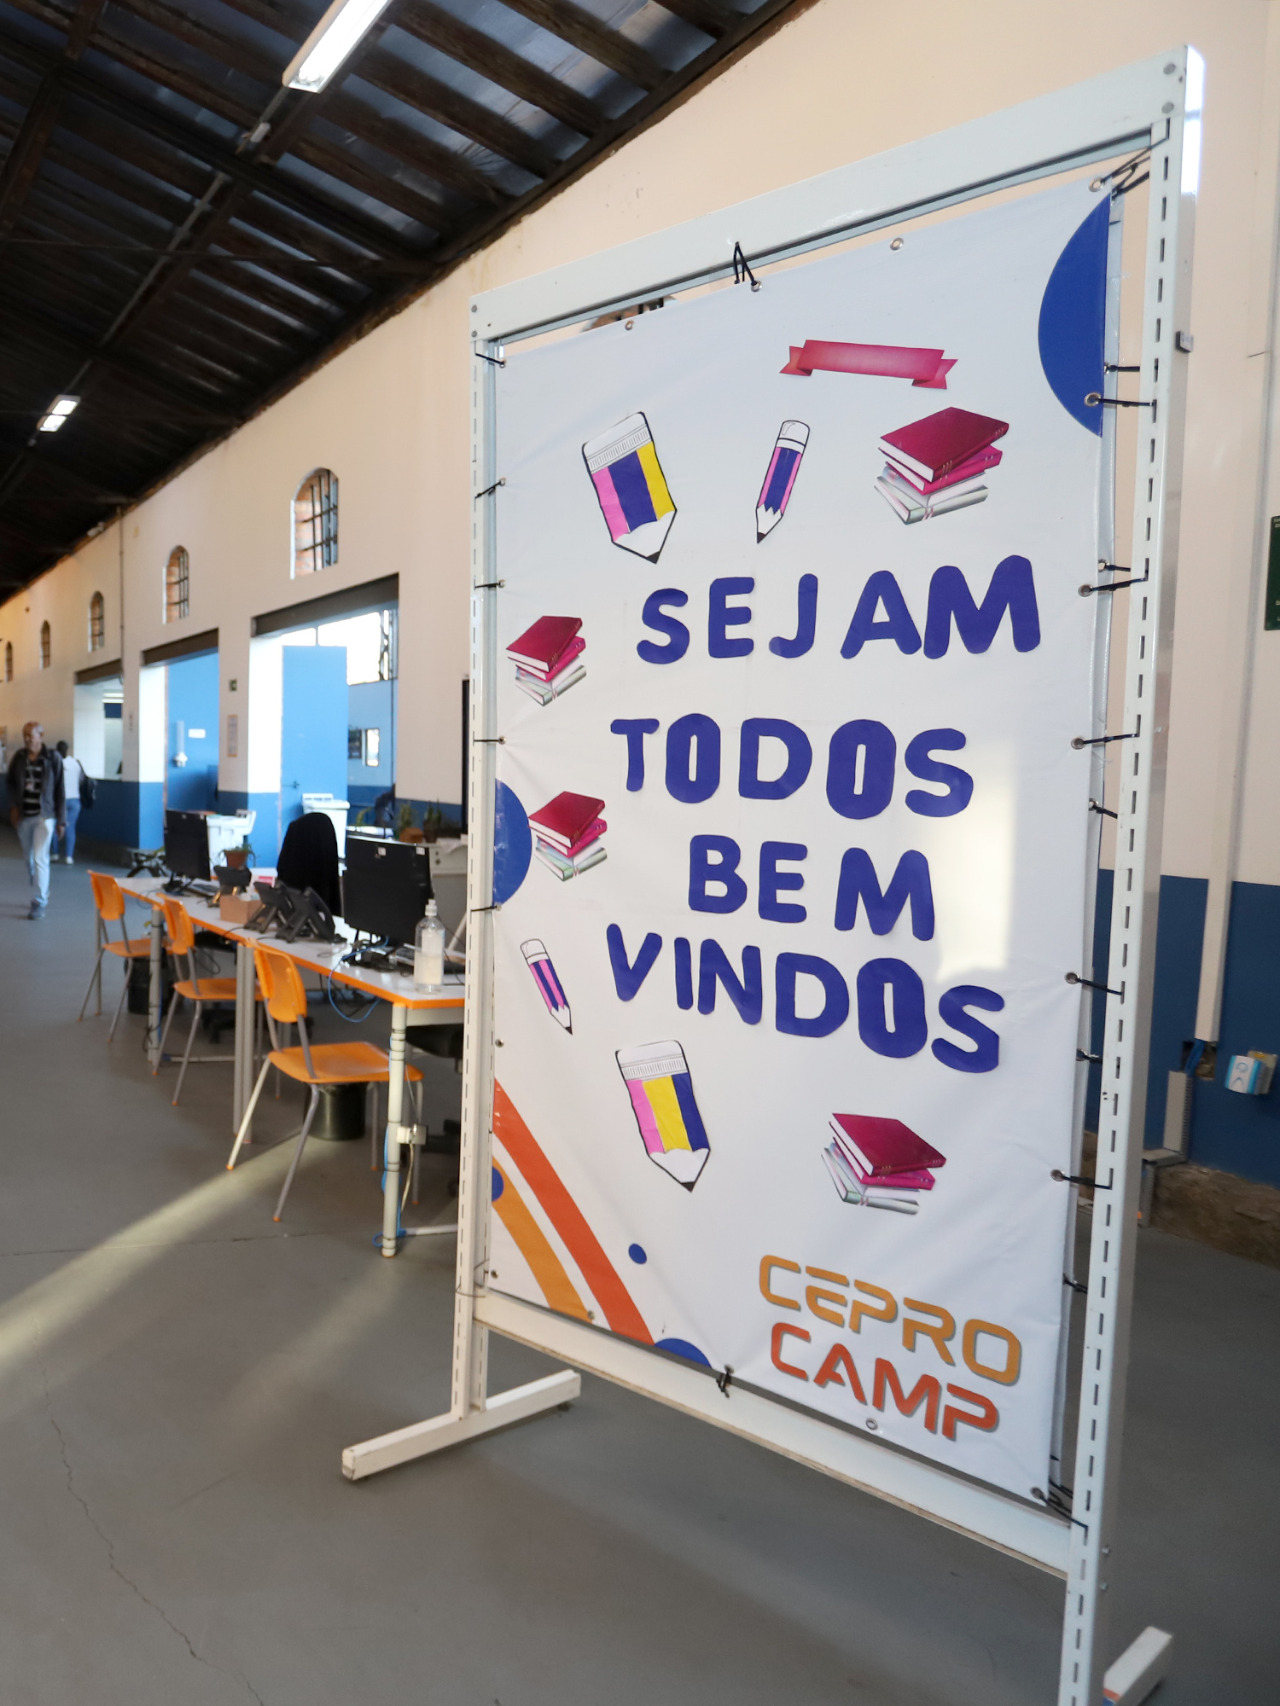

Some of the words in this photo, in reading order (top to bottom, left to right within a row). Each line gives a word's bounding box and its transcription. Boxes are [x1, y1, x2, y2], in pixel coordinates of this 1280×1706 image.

[637, 555, 1041, 665] SEJAM
[610, 713, 974, 820] TODOS
[687, 834, 935, 942] BEM
[606, 923, 1005, 1074] VINDOS
[759, 1255, 1022, 1387] CEPRO
[771, 1322, 1000, 1441] CAMP
